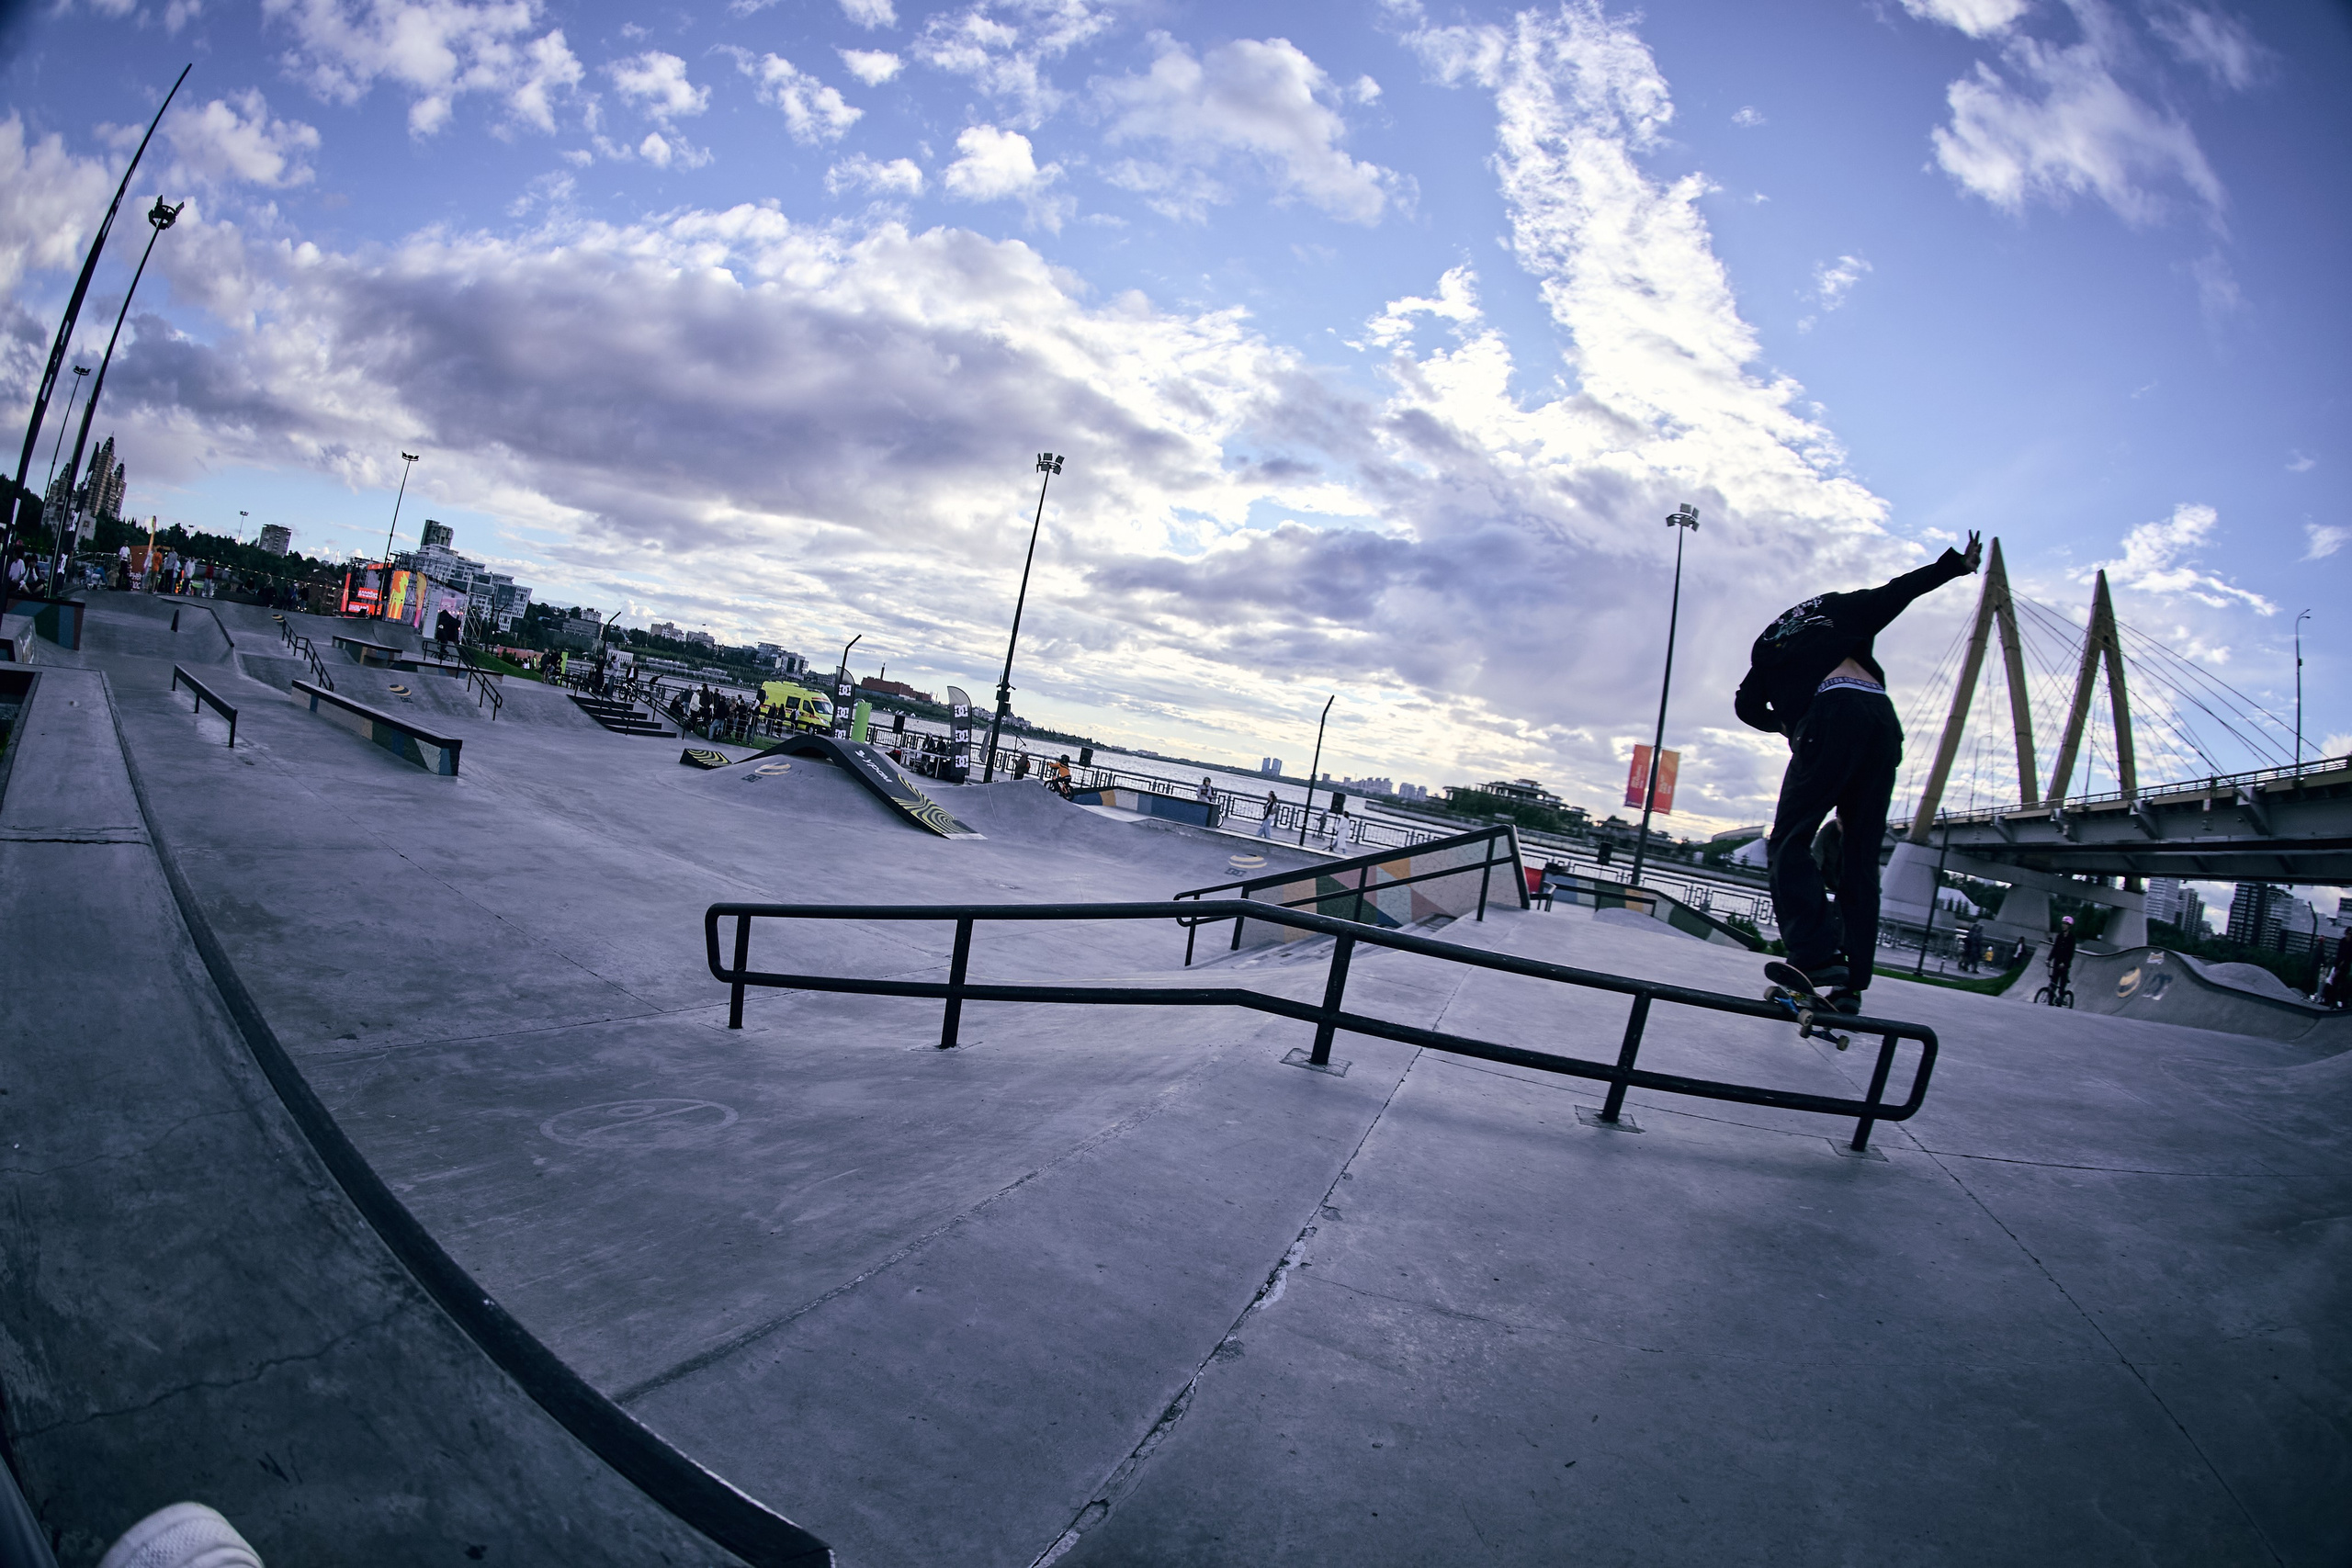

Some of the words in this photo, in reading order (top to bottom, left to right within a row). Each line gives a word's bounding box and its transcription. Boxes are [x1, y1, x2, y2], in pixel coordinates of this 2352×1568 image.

[838, 683, 852, 696] DC
[836, 705, 850, 719] DC
[954, 704, 968, 717] DC
[955, 729, 968, 743] DC
[955, 754, 969, 768] DC
